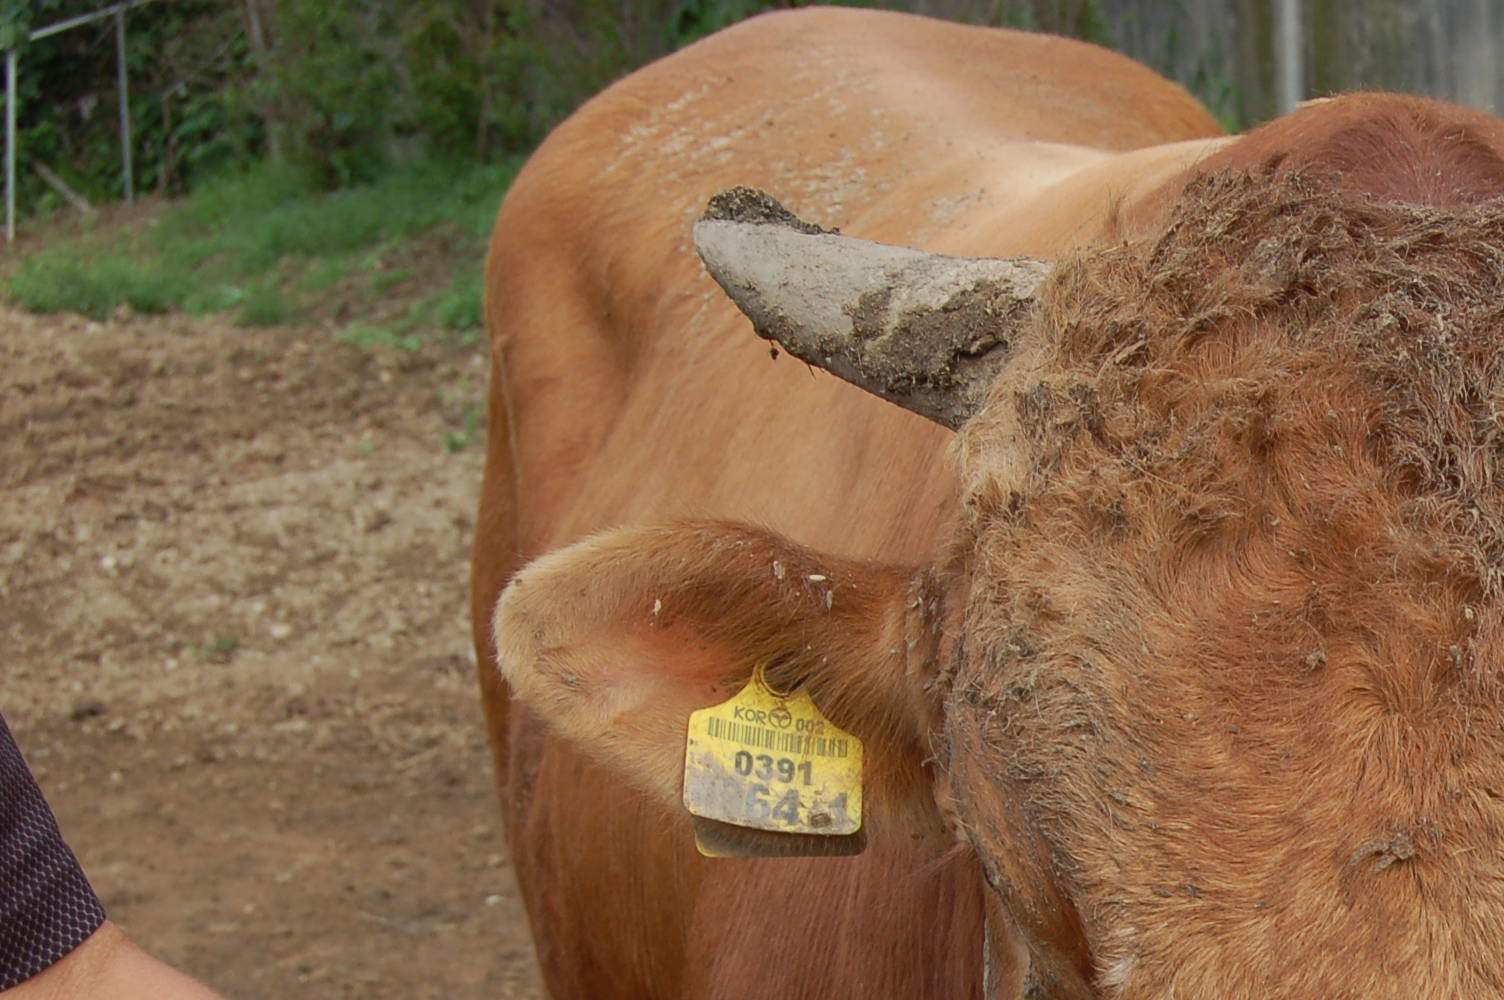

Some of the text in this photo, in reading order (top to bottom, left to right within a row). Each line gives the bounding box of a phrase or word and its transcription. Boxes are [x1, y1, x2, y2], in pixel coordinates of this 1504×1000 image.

[734, 705, 825, 735] KOR 002
[734, 750, 813, 786] 0391
